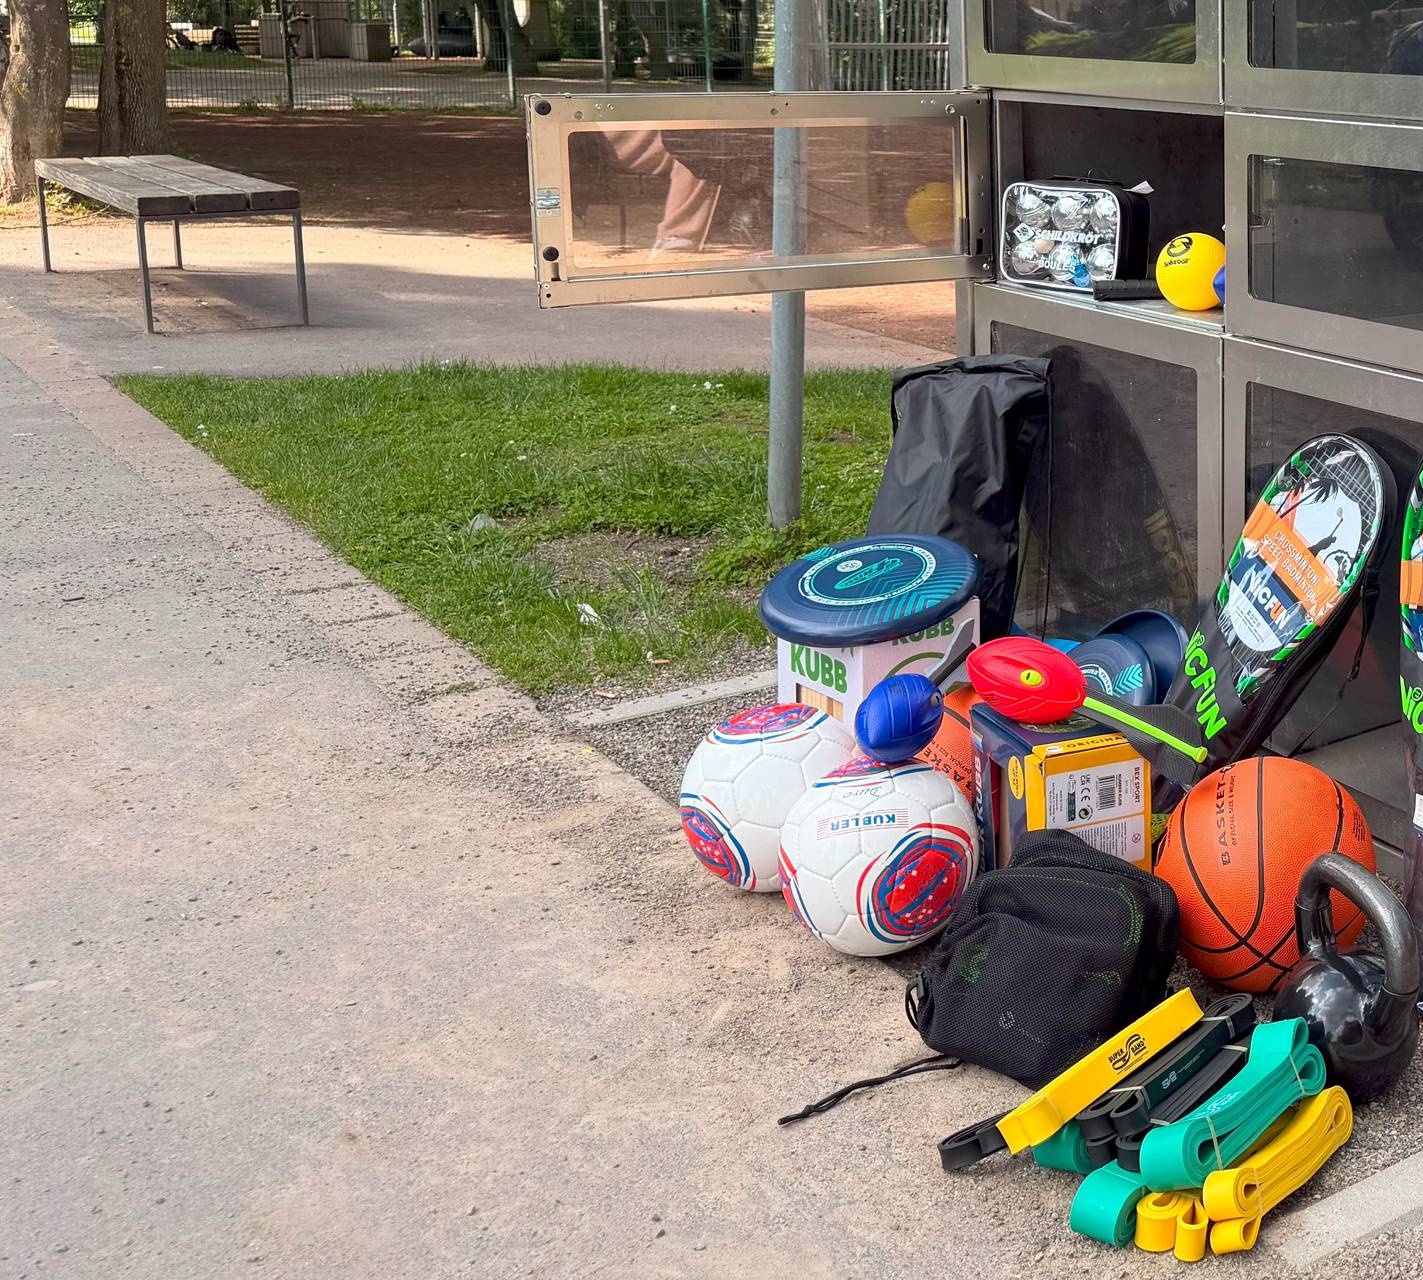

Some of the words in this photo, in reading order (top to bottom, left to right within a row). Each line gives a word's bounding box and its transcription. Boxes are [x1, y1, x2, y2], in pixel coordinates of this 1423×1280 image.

[1039, 260, 1076, 272] BOULES
[1261, 535, 1284, 560] SPEED
[790, 642, 848, 694] KUBB
[923, 747, 973, 791] BASKE
